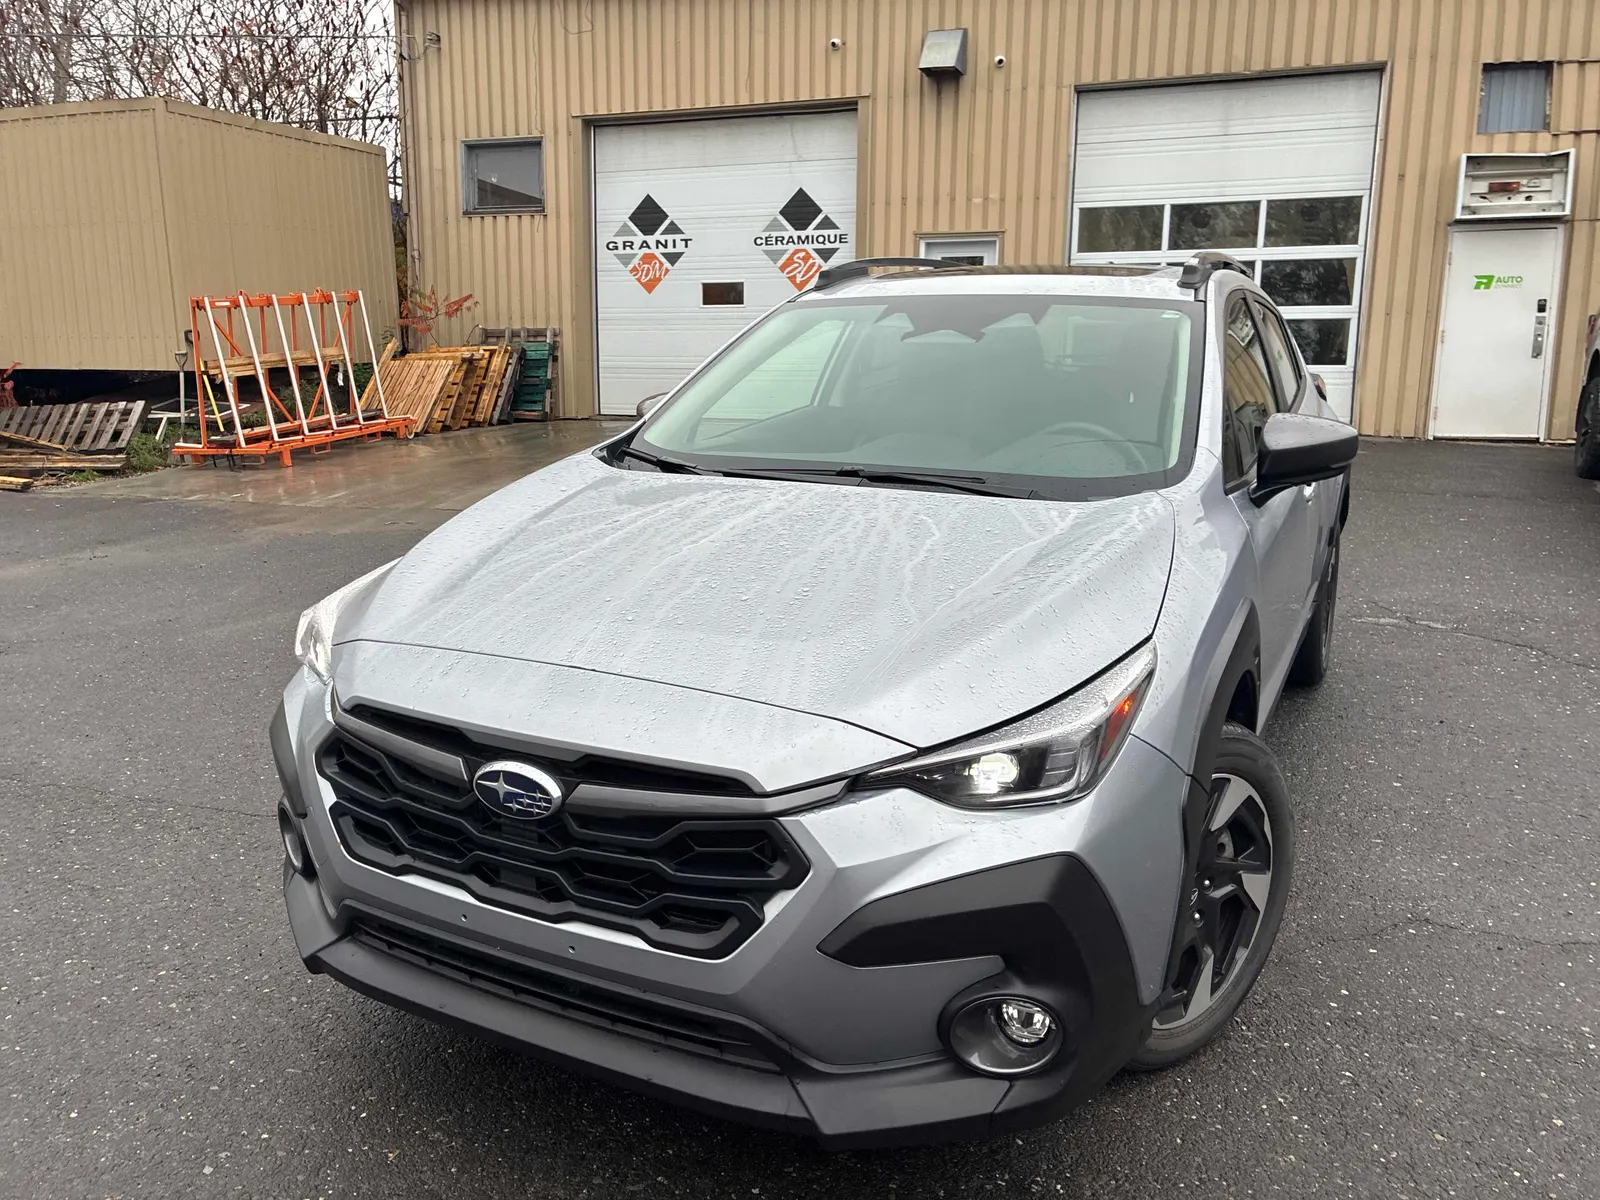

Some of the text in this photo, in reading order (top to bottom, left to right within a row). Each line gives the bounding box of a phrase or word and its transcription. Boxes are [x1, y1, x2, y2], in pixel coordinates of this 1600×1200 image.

[606, 238, 693, 251] GRANIT
[753, 233, 849, 247] CÉRAMIQUE
[1495, 276, 1523, 284] AUTO
